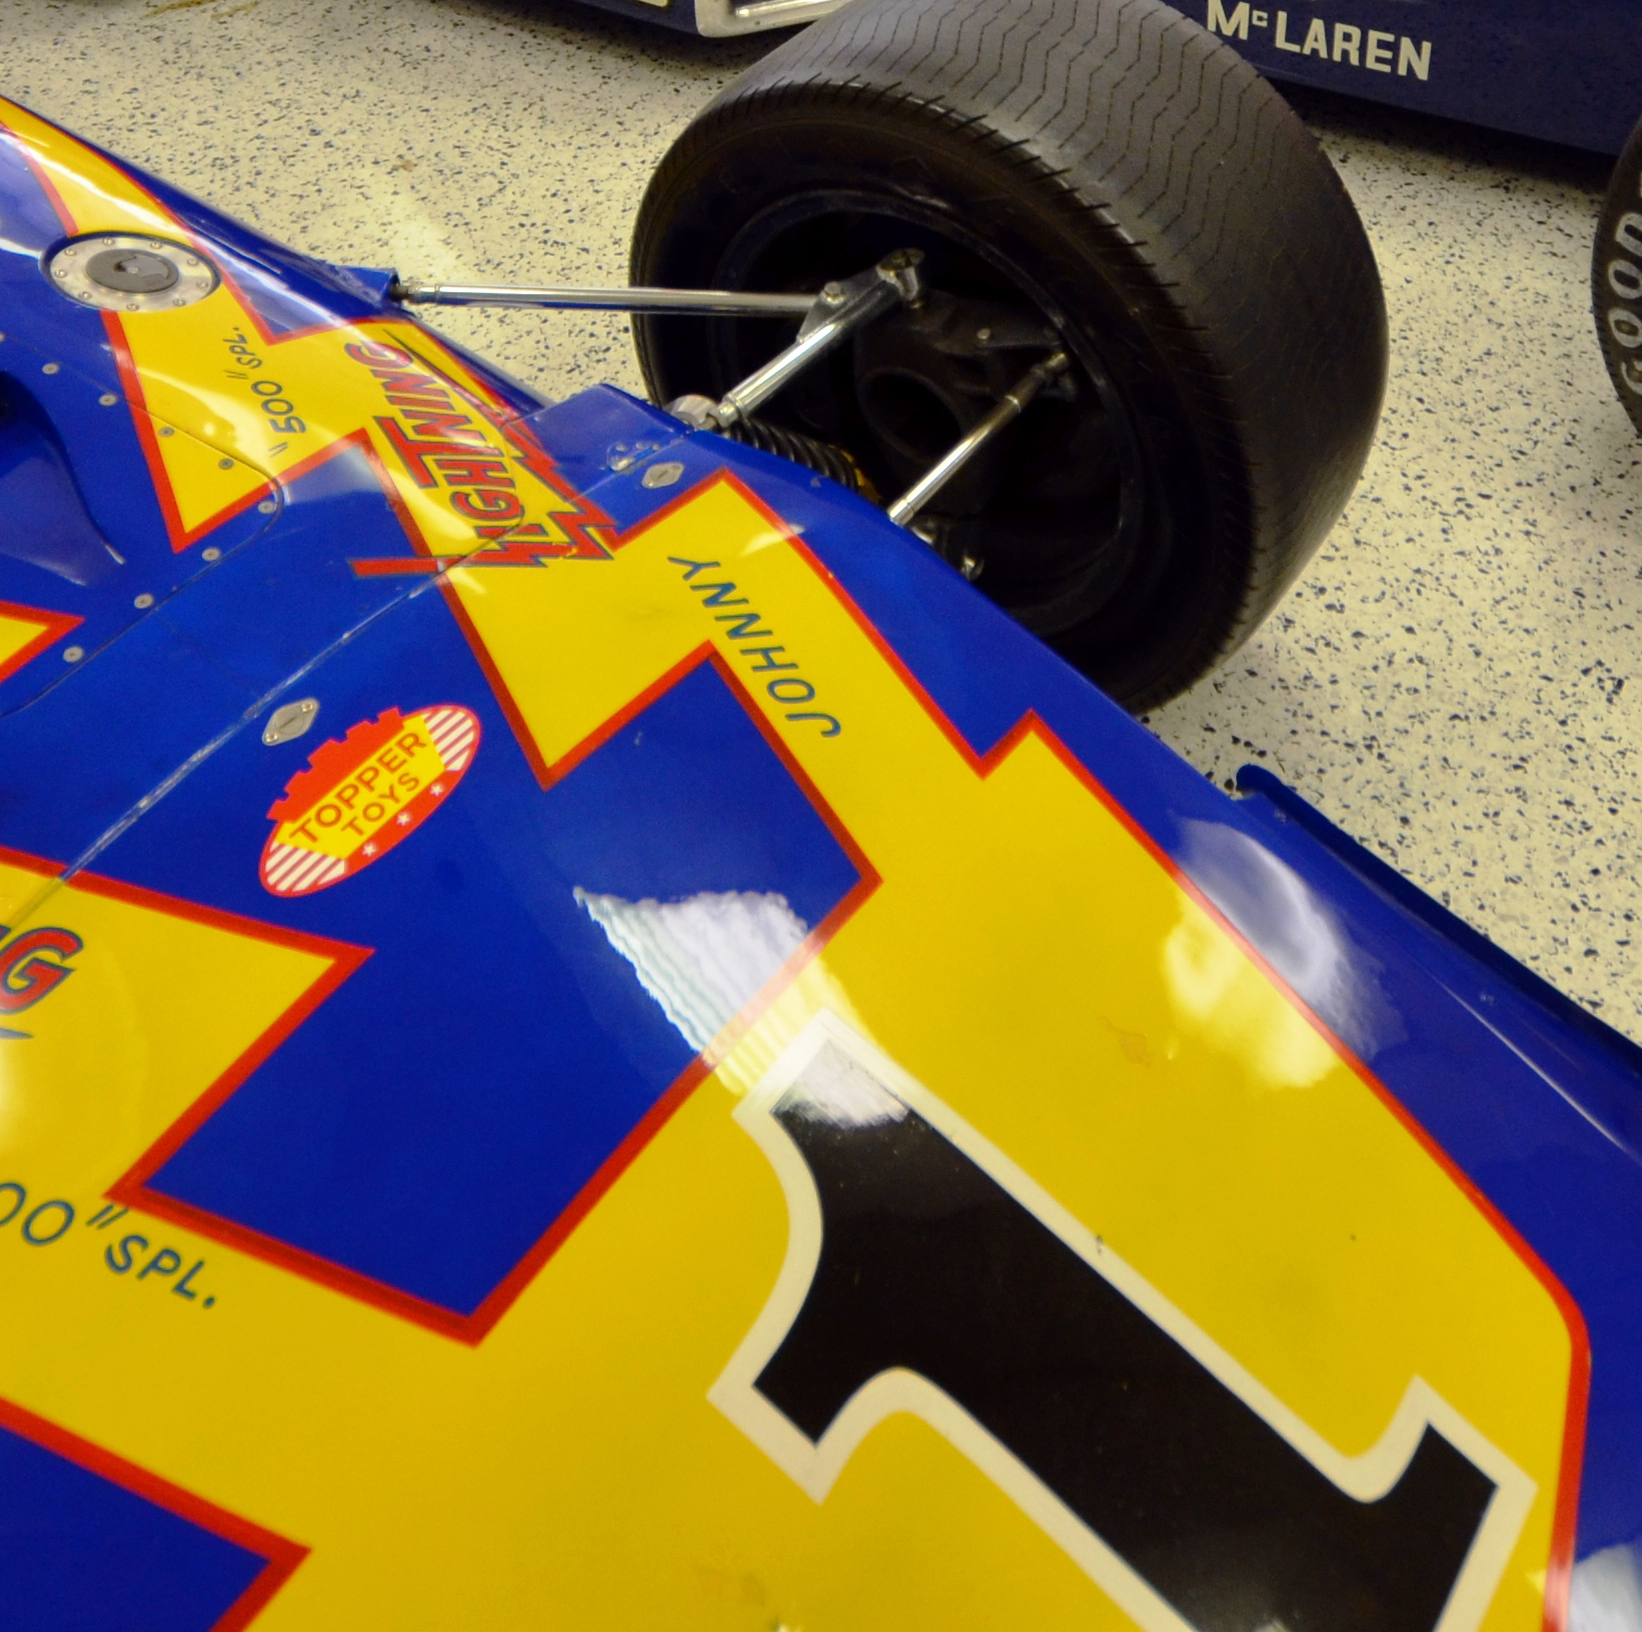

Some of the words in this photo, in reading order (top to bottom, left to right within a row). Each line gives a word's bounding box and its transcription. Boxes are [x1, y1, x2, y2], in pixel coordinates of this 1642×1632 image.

[667, 552, 843, 742] JOHNNY
[289, 728, 430, 850] TOPPER
[339, 769, 423, 843] TOYS
[103, 1231, 220, 1310] SPL.
[703, 1004, 1540, 1632] 1
